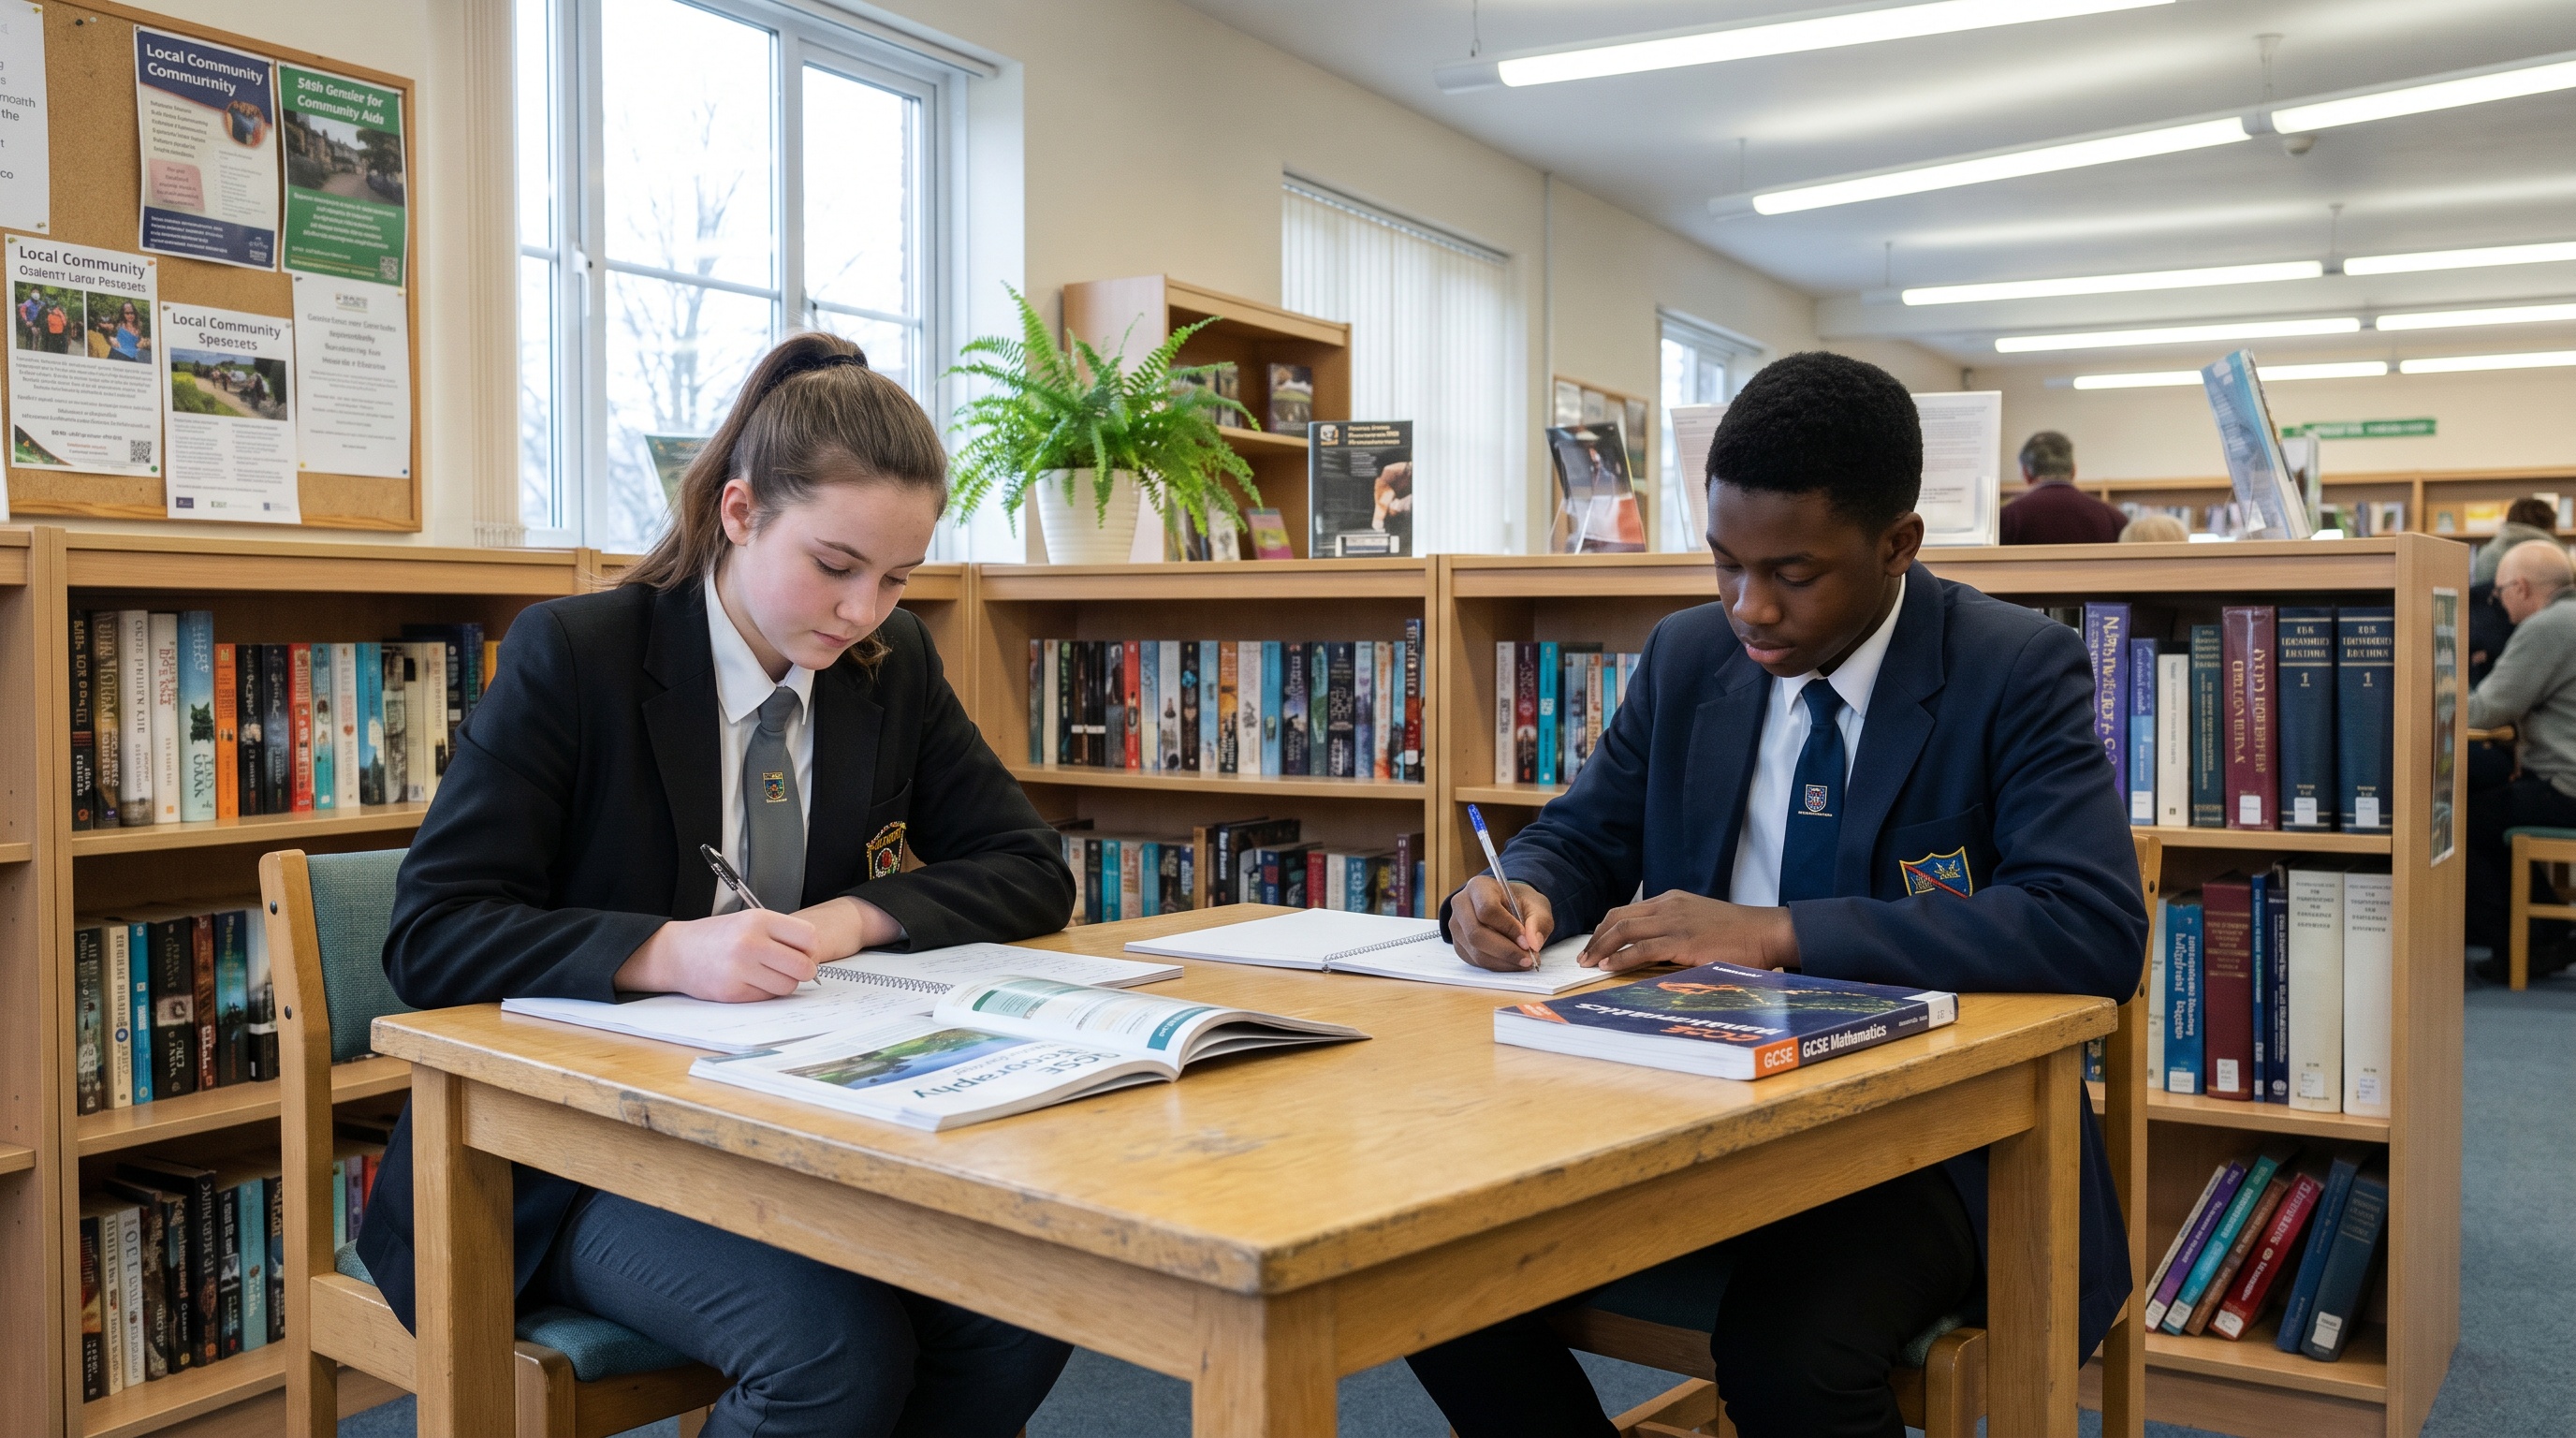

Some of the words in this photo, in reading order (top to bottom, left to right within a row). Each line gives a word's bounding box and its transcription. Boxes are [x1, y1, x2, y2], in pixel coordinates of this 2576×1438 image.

[146, 44, 184, 64] Local
[187, 51, 264, 85] Community
[298, 95, 359, 122] Community
[367, 94, 384, 107] for
[1, 109, 20, 122] the
[20, 245, 58, 263] Local
[63, 253, 146, 280] Community
[172, 312, 206, 328] Local
[210, 317, 282, 341] Community
[1764, 1046, 1793, 1069] GCSE
[1802, 1036, 1829, 1058] GCSE
